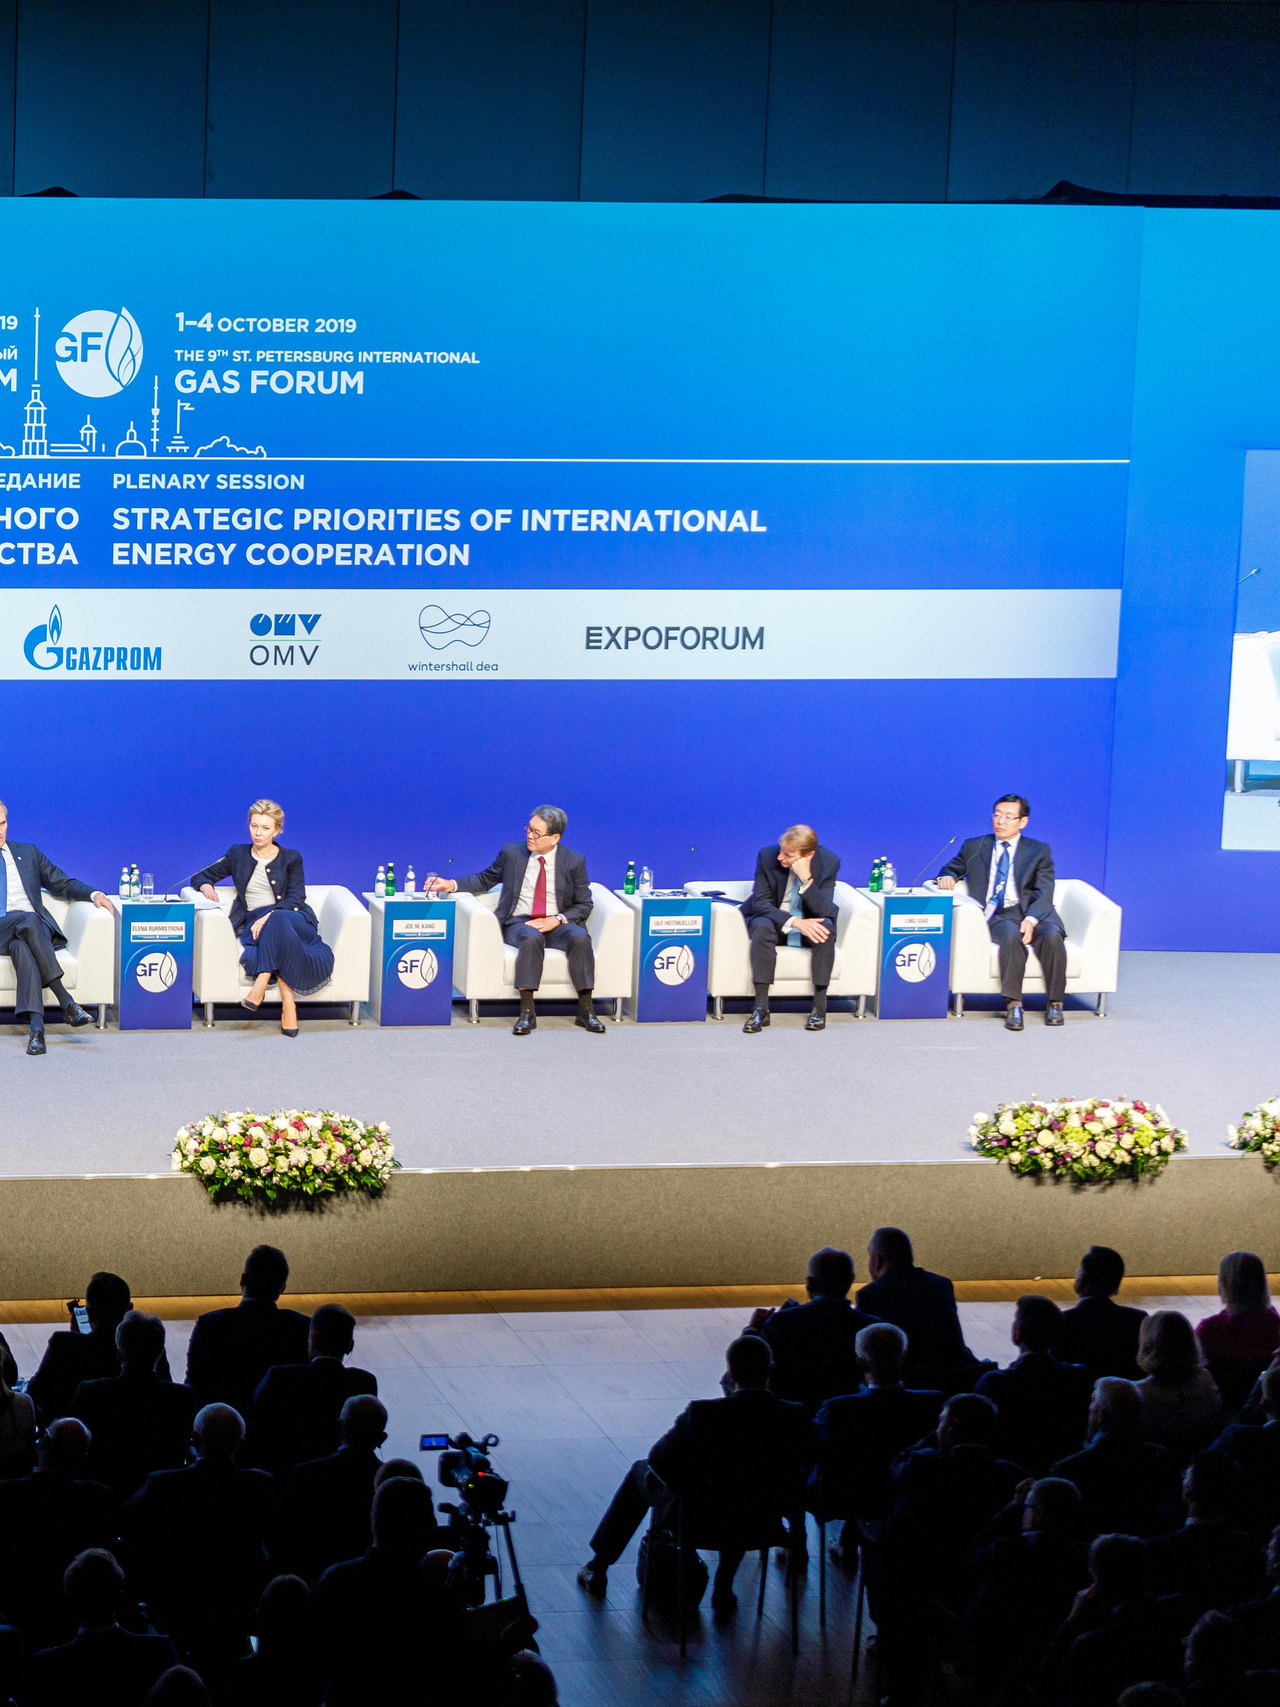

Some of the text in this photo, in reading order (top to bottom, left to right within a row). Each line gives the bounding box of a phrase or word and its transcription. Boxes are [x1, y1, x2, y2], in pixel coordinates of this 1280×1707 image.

[175, 311, 357, 333] 1–4 OCTOBER 2019
[55, 331, 104, 363] GF
[174, 349, 204, 362] THE
[232, 350, 252, 362] ST.
[256, 350, 354, 363] PETERSBURG
[358, 351, 481, 364] INTERNATIONAL
[174, 369, 364, 395] GAS FORUM
[113, 474, 305, 490] PLENARY SESSION
[112, 508, 768, 533] STRATEGIC PRIORITIES OF INTERNATIONAL
[112, 542, 470, 566] ENERGY COOPERATION
[585, 625, 765, 651] EXPOFORUM
[65, 646, 163, 671] GAZPROM
[249, 645, 320, 666] OMV
[407, 661, 499, 672] wintershall dea
[136, 963, 159, 977] GF
[397, 959, 420, 974] GF
[654, 956, 676, 970] GF
[895, 953, 918, 967] GF
